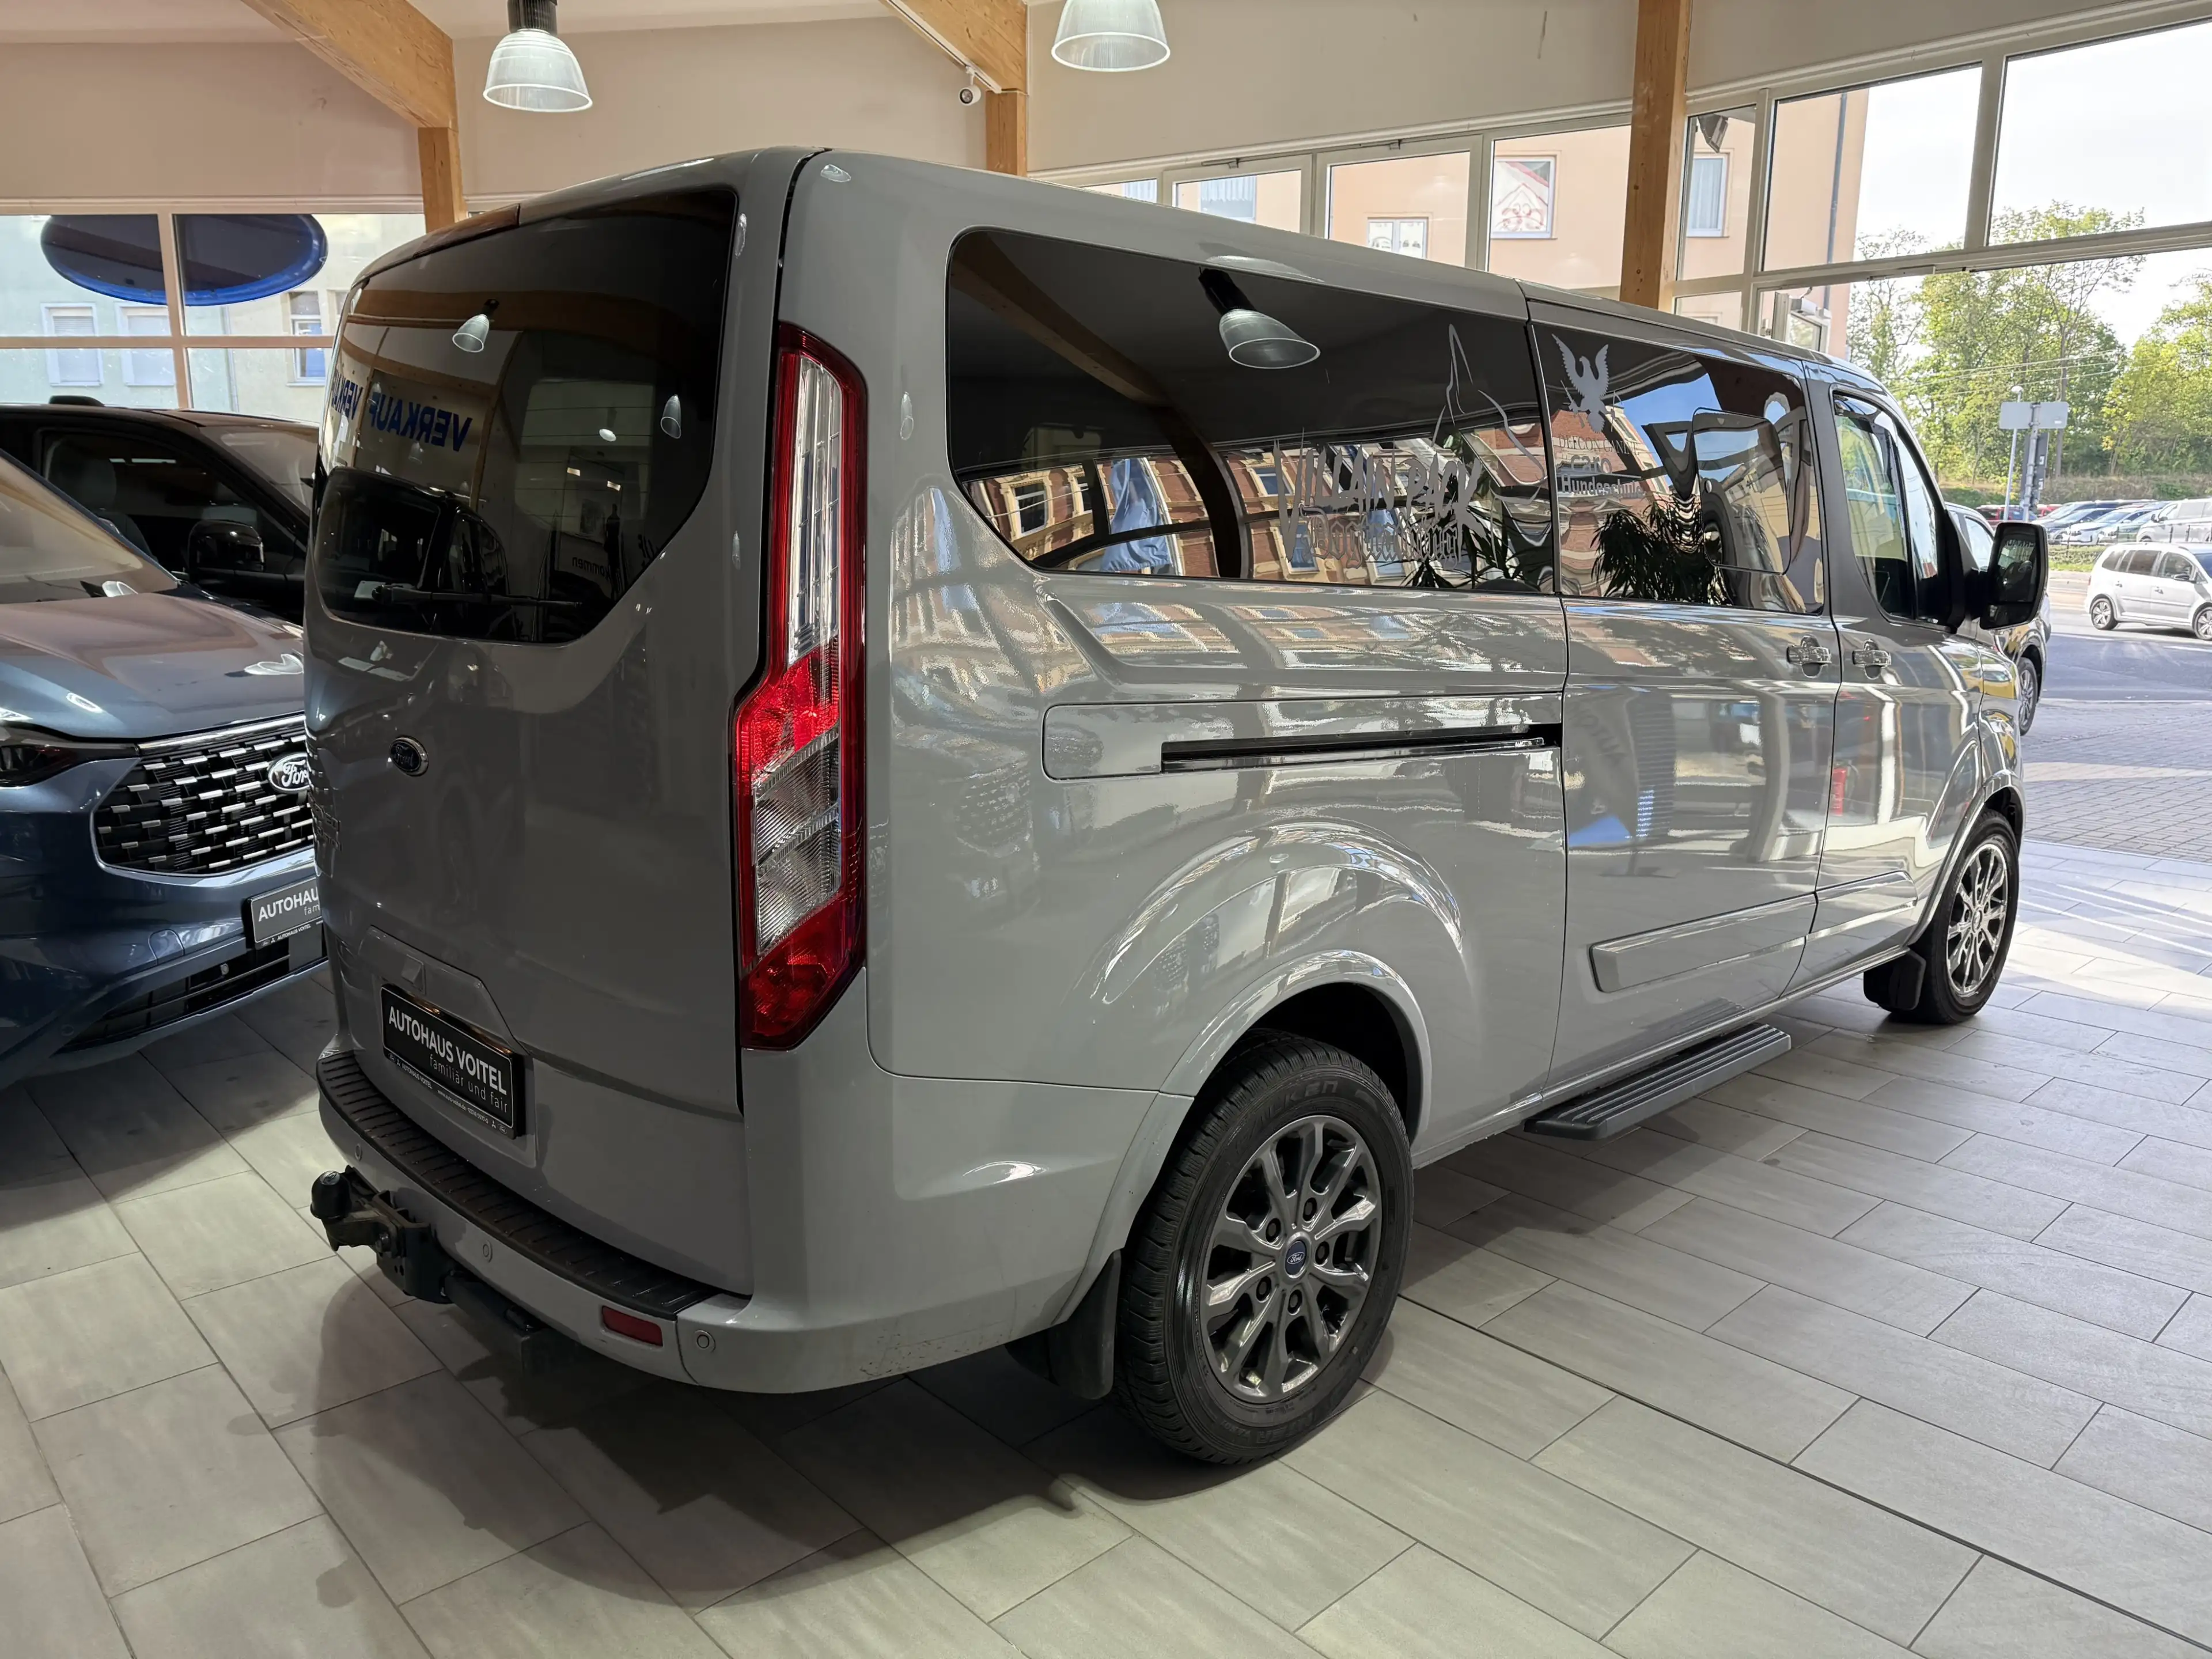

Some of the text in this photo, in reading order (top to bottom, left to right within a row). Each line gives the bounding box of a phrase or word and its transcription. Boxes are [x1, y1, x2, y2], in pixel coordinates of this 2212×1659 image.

[1559, 434, 1641, 456] DEFCON CANINE
[1272, 429, 1491, 563] VILLAIN PACK
[1560, 474, 1643, 498] Hundeschule
[388, 1006, 507, 1096] AUTOHAUS VOITEL
[429, 1054, 507, 1113] familiär und fair
[1290, 1253, 1302, 1263] Ford
